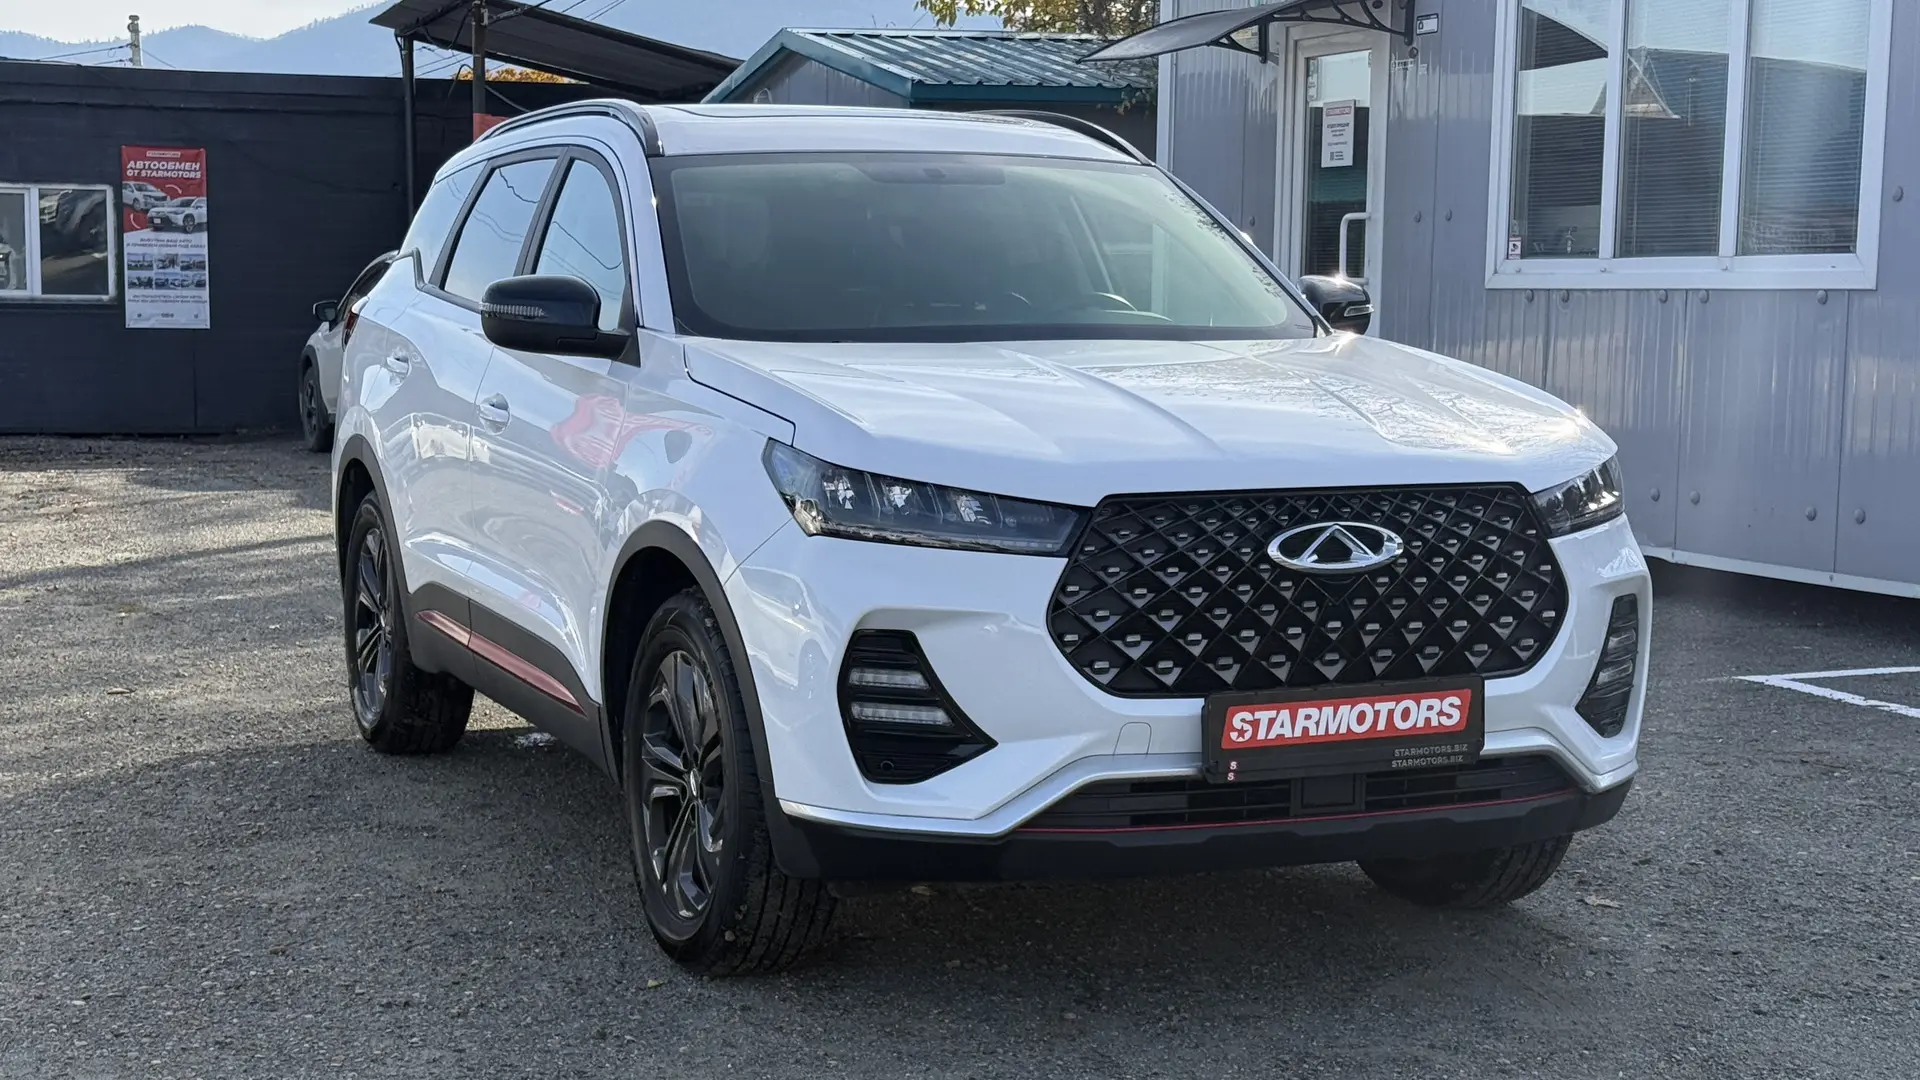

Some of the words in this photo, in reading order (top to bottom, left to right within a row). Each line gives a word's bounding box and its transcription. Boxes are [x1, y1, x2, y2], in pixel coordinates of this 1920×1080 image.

[127, 160, 200, 171] АВТООБМЕН
[126, 169, 140, 177] ОТ
[141, 169, 202, 179] STARMOTORS
[1229, 696, 1462, 743] STARMOTORS
[1394, 743, 1468, 757] STARMOTORS.BIZ
[1391, 755, 1464, 768] STARMOTORS.BIZ
